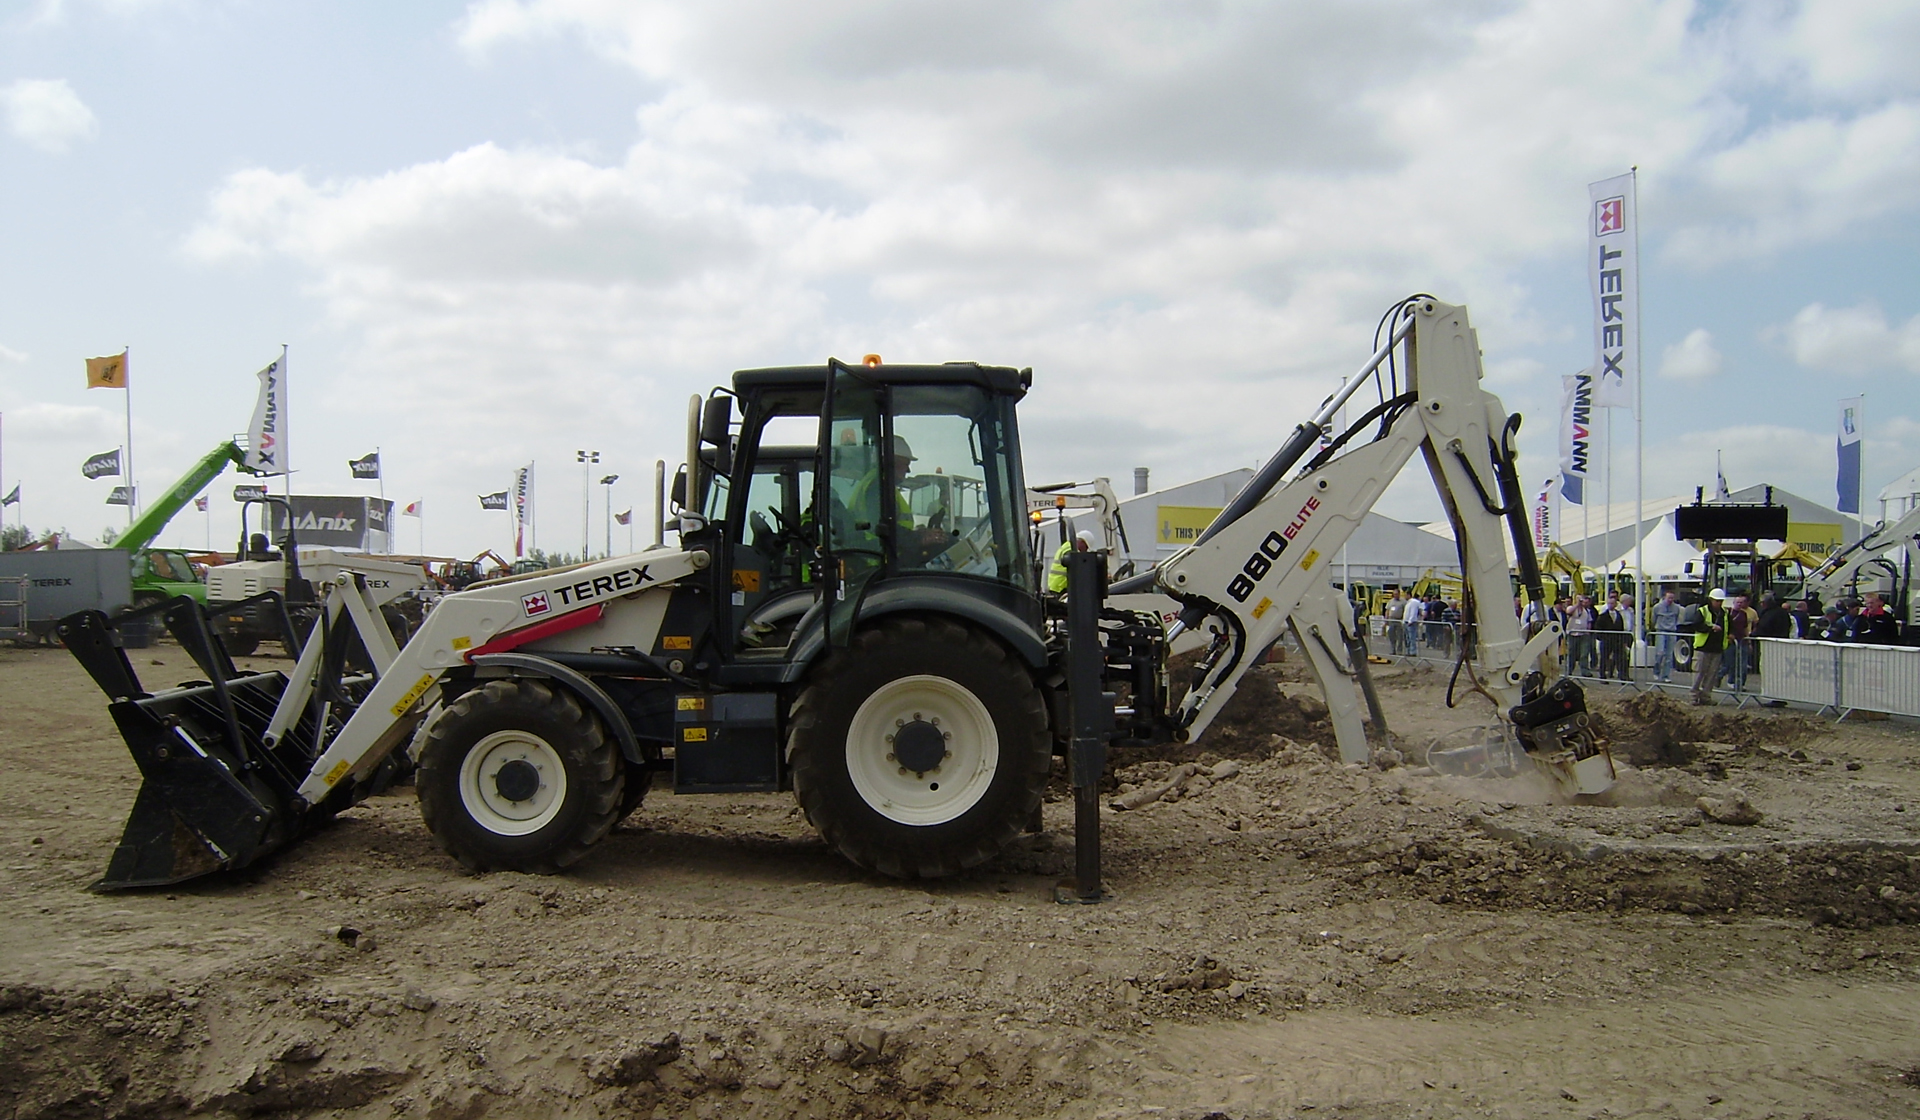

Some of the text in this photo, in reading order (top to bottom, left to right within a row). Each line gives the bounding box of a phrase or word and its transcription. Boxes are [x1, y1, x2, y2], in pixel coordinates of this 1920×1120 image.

[1571, 374, 1592, 473] AMMANN
[1175, 527, 1193, 539] THIS
[1226, 496, 1321, 603] 880 ELITE
[32, 578, 72, 587] TEREX
[366, 579, 390, 589] REX
[554, 564, 655, 605] TEREX
